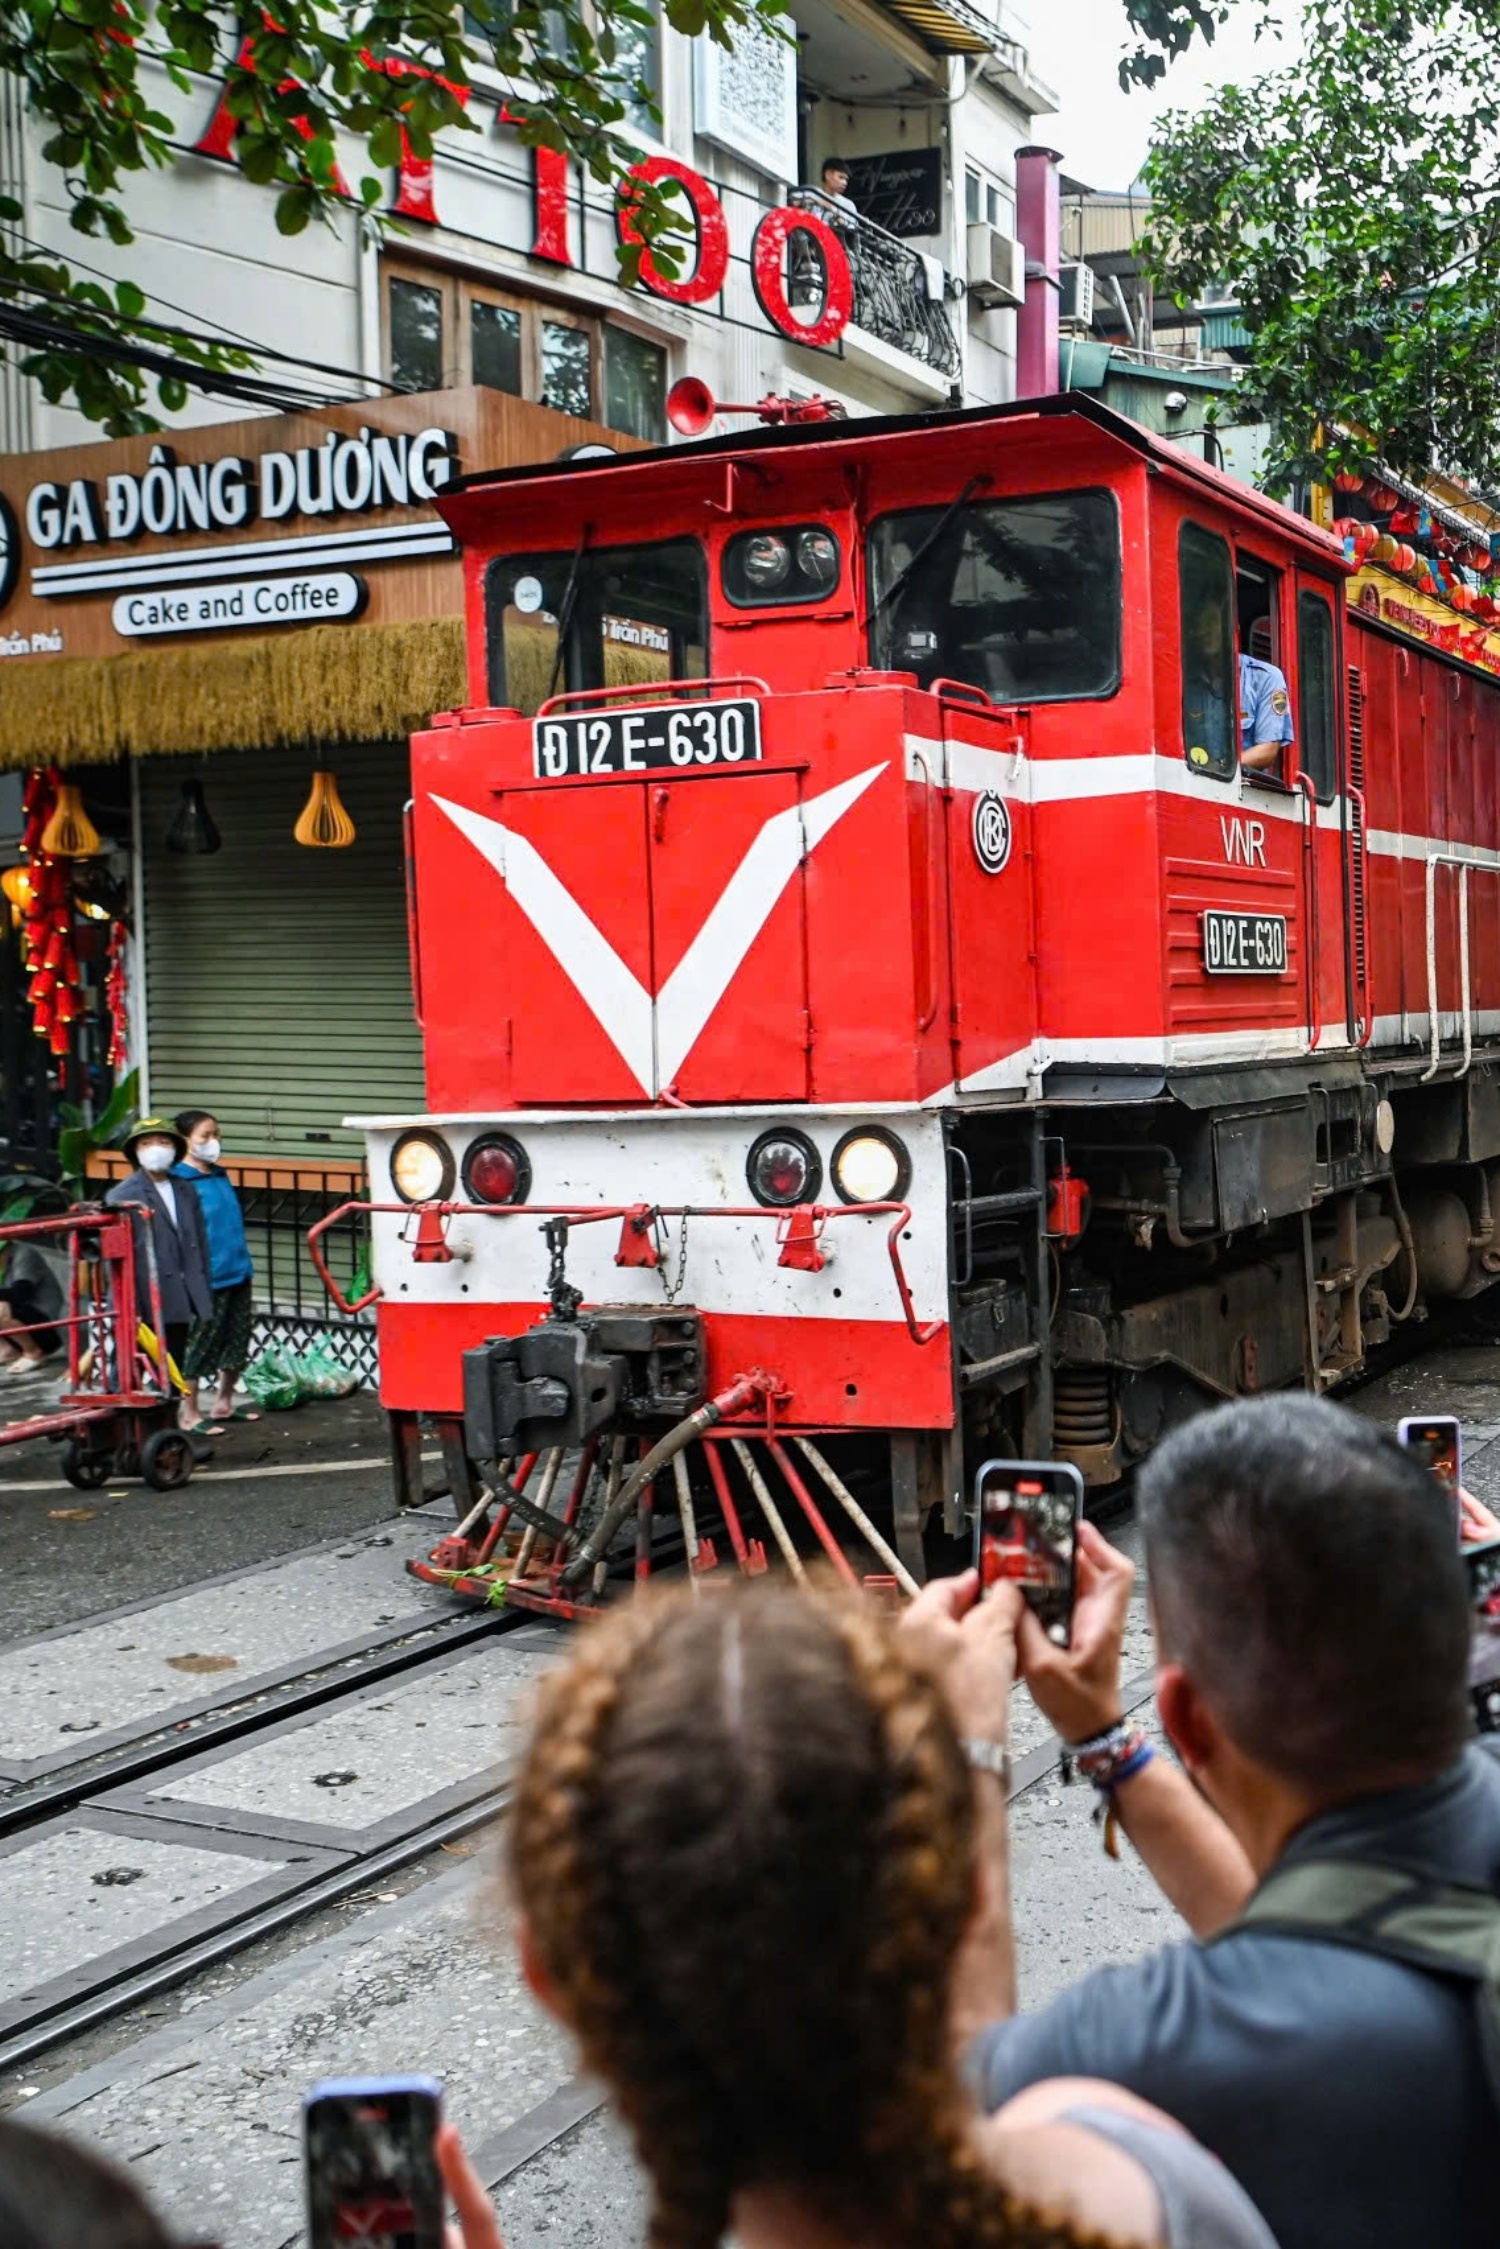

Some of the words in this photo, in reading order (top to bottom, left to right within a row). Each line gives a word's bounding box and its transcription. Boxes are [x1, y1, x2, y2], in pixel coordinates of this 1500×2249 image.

[95, 2, 854, 347] TTOO
[854, 188, 936, 231] Tttoo
[26, 481, 97, 548] GA
[105, 444, 248, 539] ĐÔNG
[259, 425, 451, 519] DƯƠNG
[127, 597, 190, 627] Cake
[199, 589, 244, 620] and
[254, 582, 340, 615] Coffee
[1220, 815, 1267, 867] VNR
